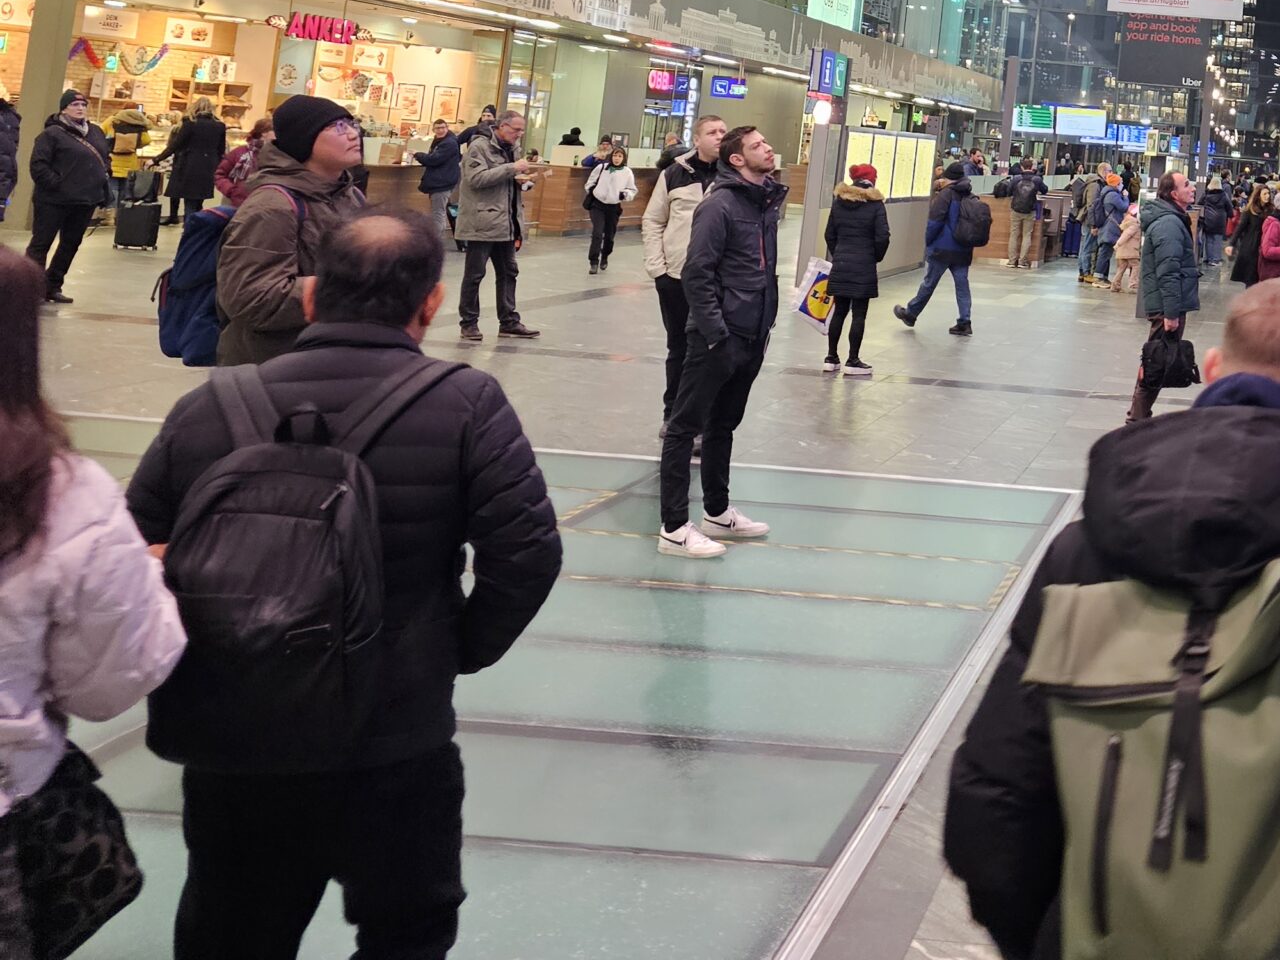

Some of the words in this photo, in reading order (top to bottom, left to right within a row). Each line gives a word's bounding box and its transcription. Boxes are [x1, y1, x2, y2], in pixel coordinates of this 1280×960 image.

[286, 11, 357, 45] ANKER
[1127, 21, 1148, 30] app
[1149, 22, 1169, 32] and
[1171, 23, 1197, 33] book
[1126, 31, 1148, 41] your
[1150, 33, 1170, 43] ride
[1182, 77, 1202, 87] Uber
